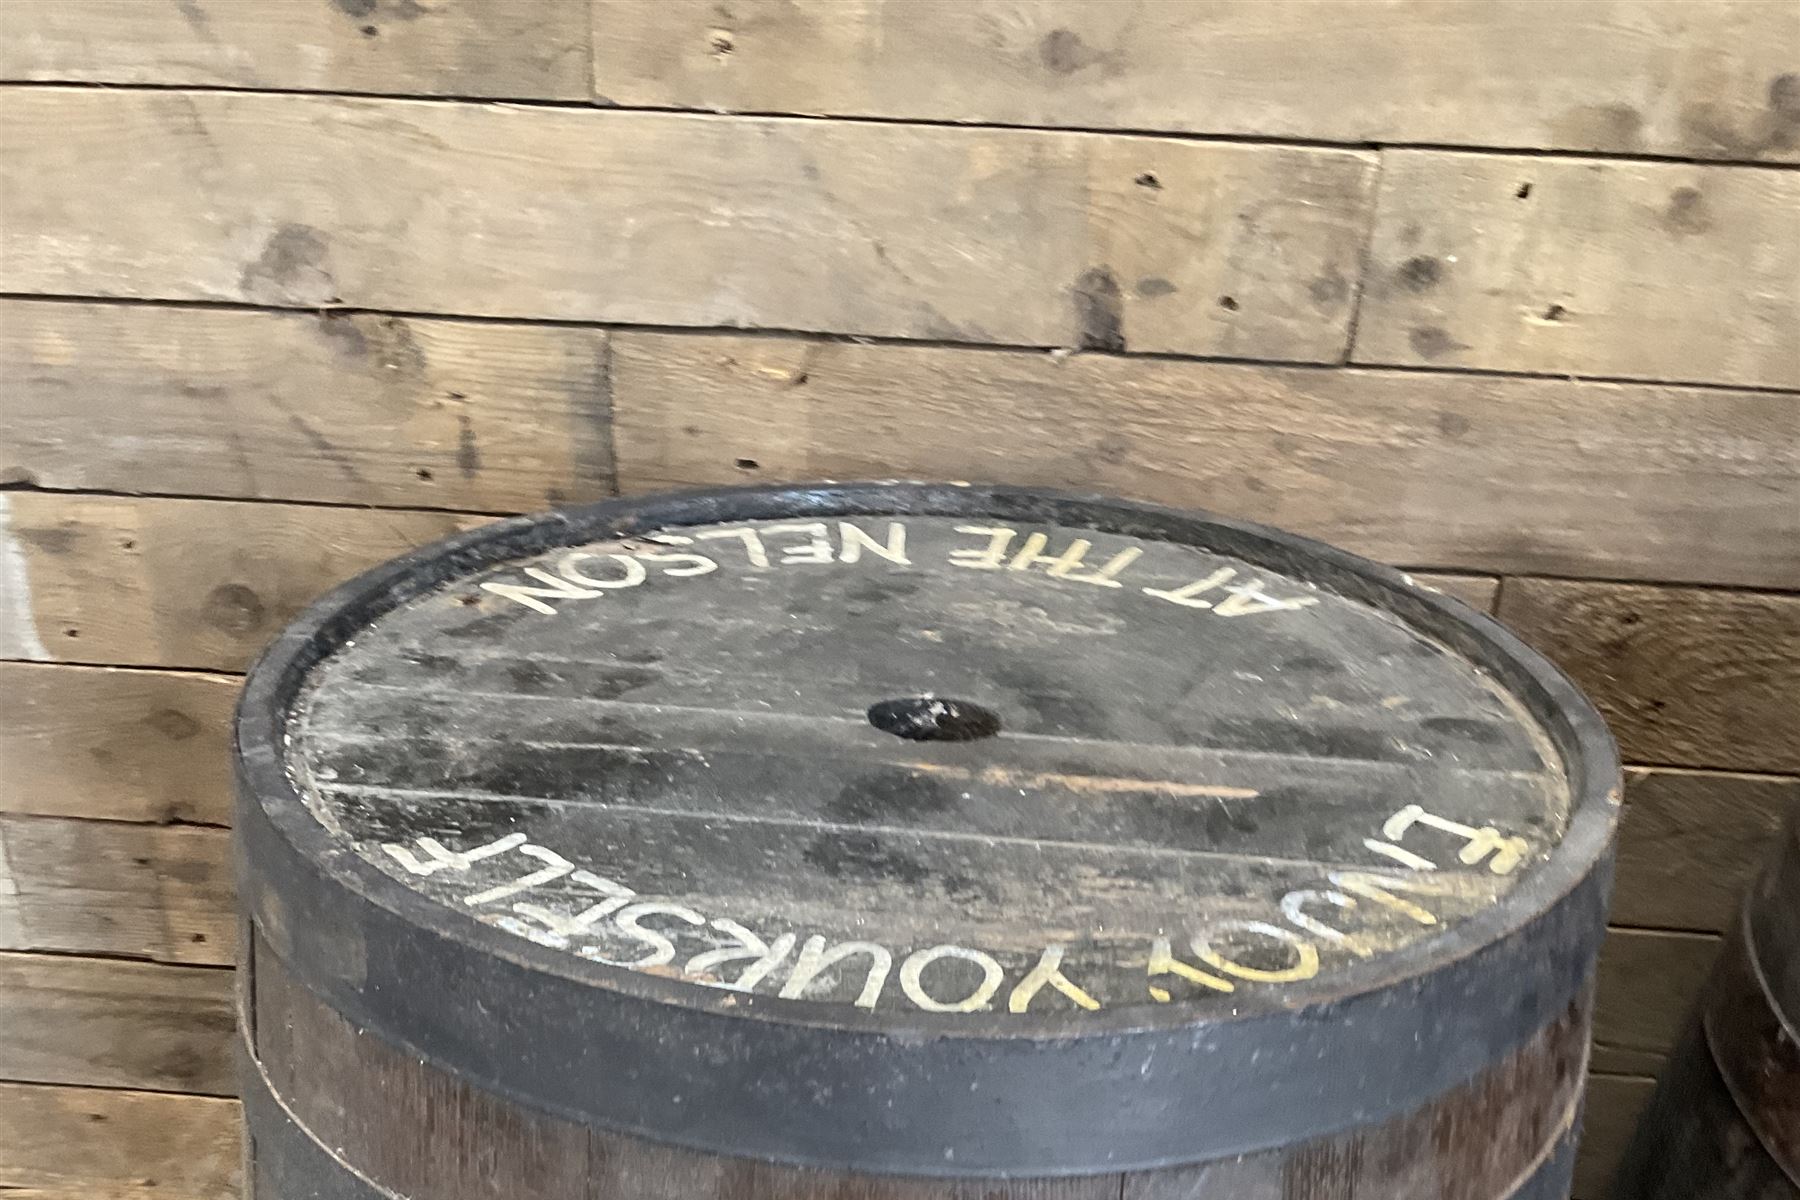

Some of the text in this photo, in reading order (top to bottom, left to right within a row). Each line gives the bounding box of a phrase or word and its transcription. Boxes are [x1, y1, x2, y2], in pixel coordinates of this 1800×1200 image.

[479, 521, 1320, 617] AT THE NELSON
[380, 803, 1530, 1013] ENJOY YOURSELF
